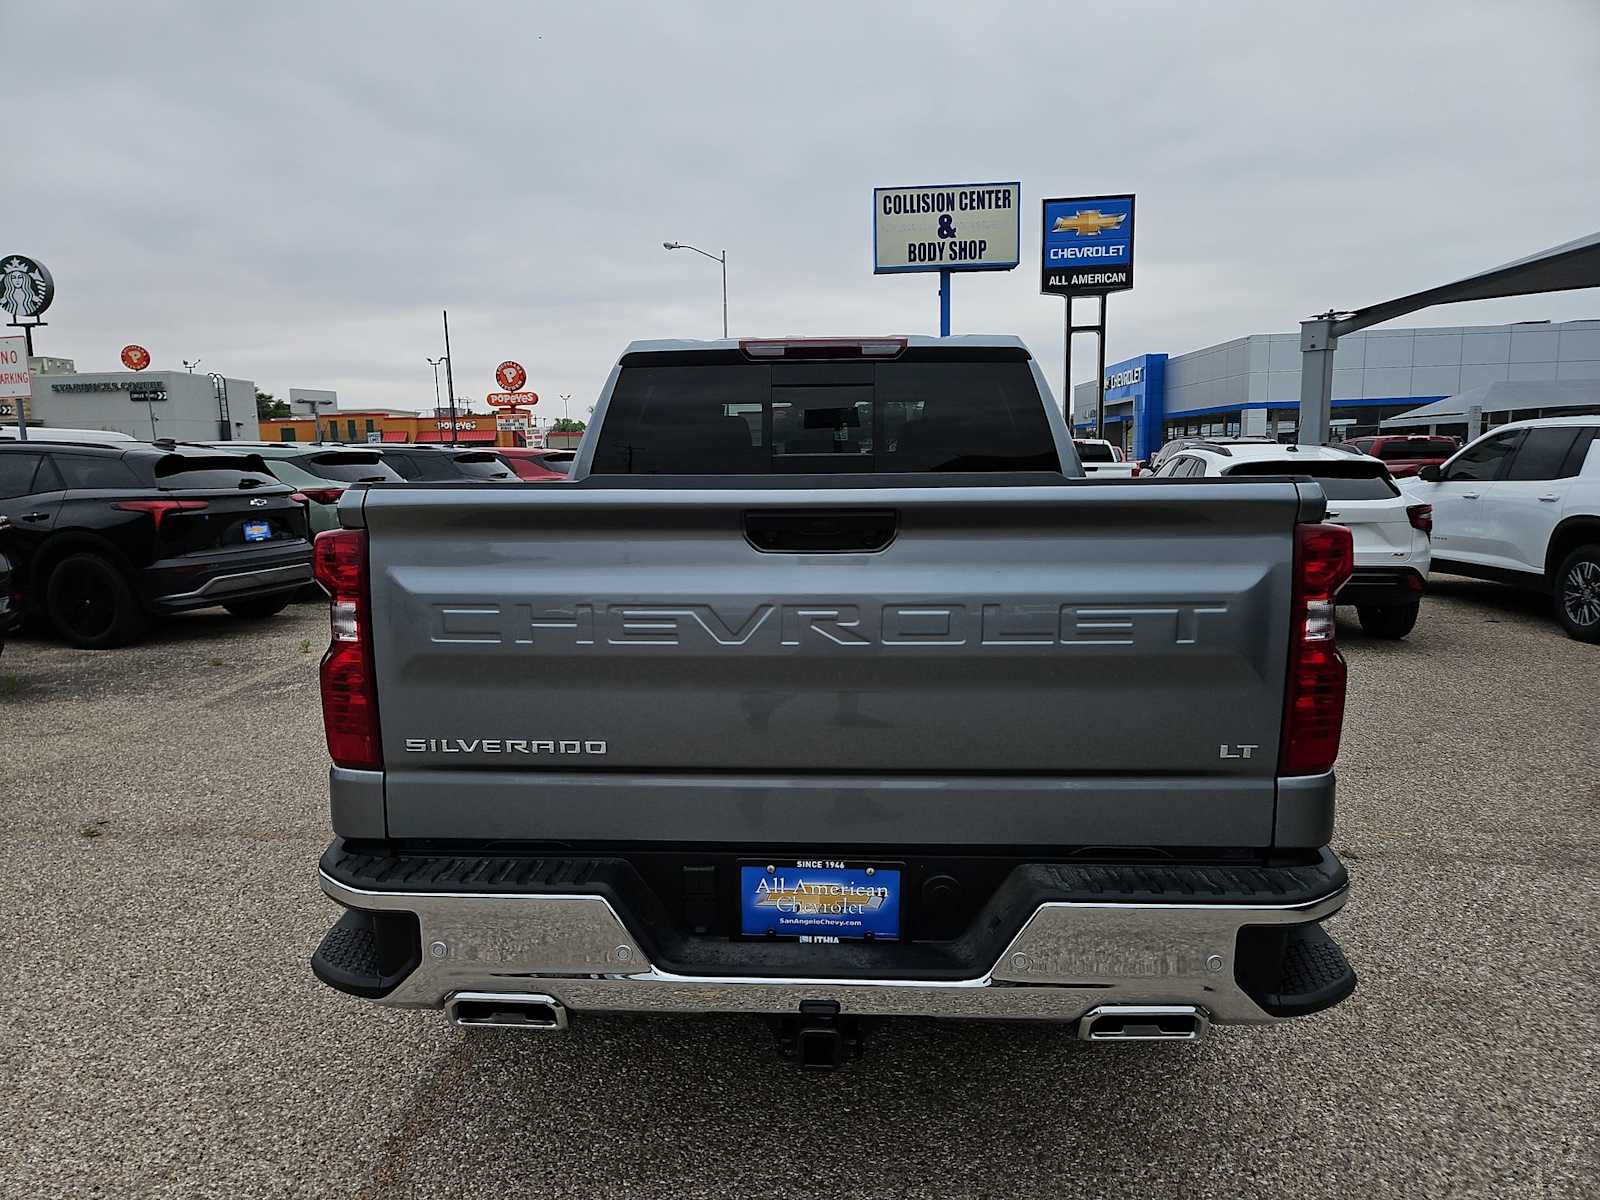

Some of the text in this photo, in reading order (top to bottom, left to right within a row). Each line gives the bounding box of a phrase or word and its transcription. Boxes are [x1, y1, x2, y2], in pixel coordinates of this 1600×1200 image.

[883, 189, 1011, 215] COLLISION CENTER
[937, 214, 957, 239] &
[908, 240, 987, 262] BODY SHOP
[1050, 245, 1125, 259] CHEVROLET
[1049, 272, 1126, 286] ALL AMERICAN
[0, 350, 17, 364] NO
[0, 372, 29, 385] ARKING
[1110, 367, 1142, 389] CHEVROLET
[430, 602, 1229, 647] CHEVROLET
[405, 738, 608, 755] SILVERADO
[1219, 744, 1259, 759] LT
[797, 860, 845, 869] SINCE 1946
[755, 877, 889, 898] All American
[776, 895, 864, 915] Chevrolet
[779, 917, 862, 927] SanAngeloChevy.com
